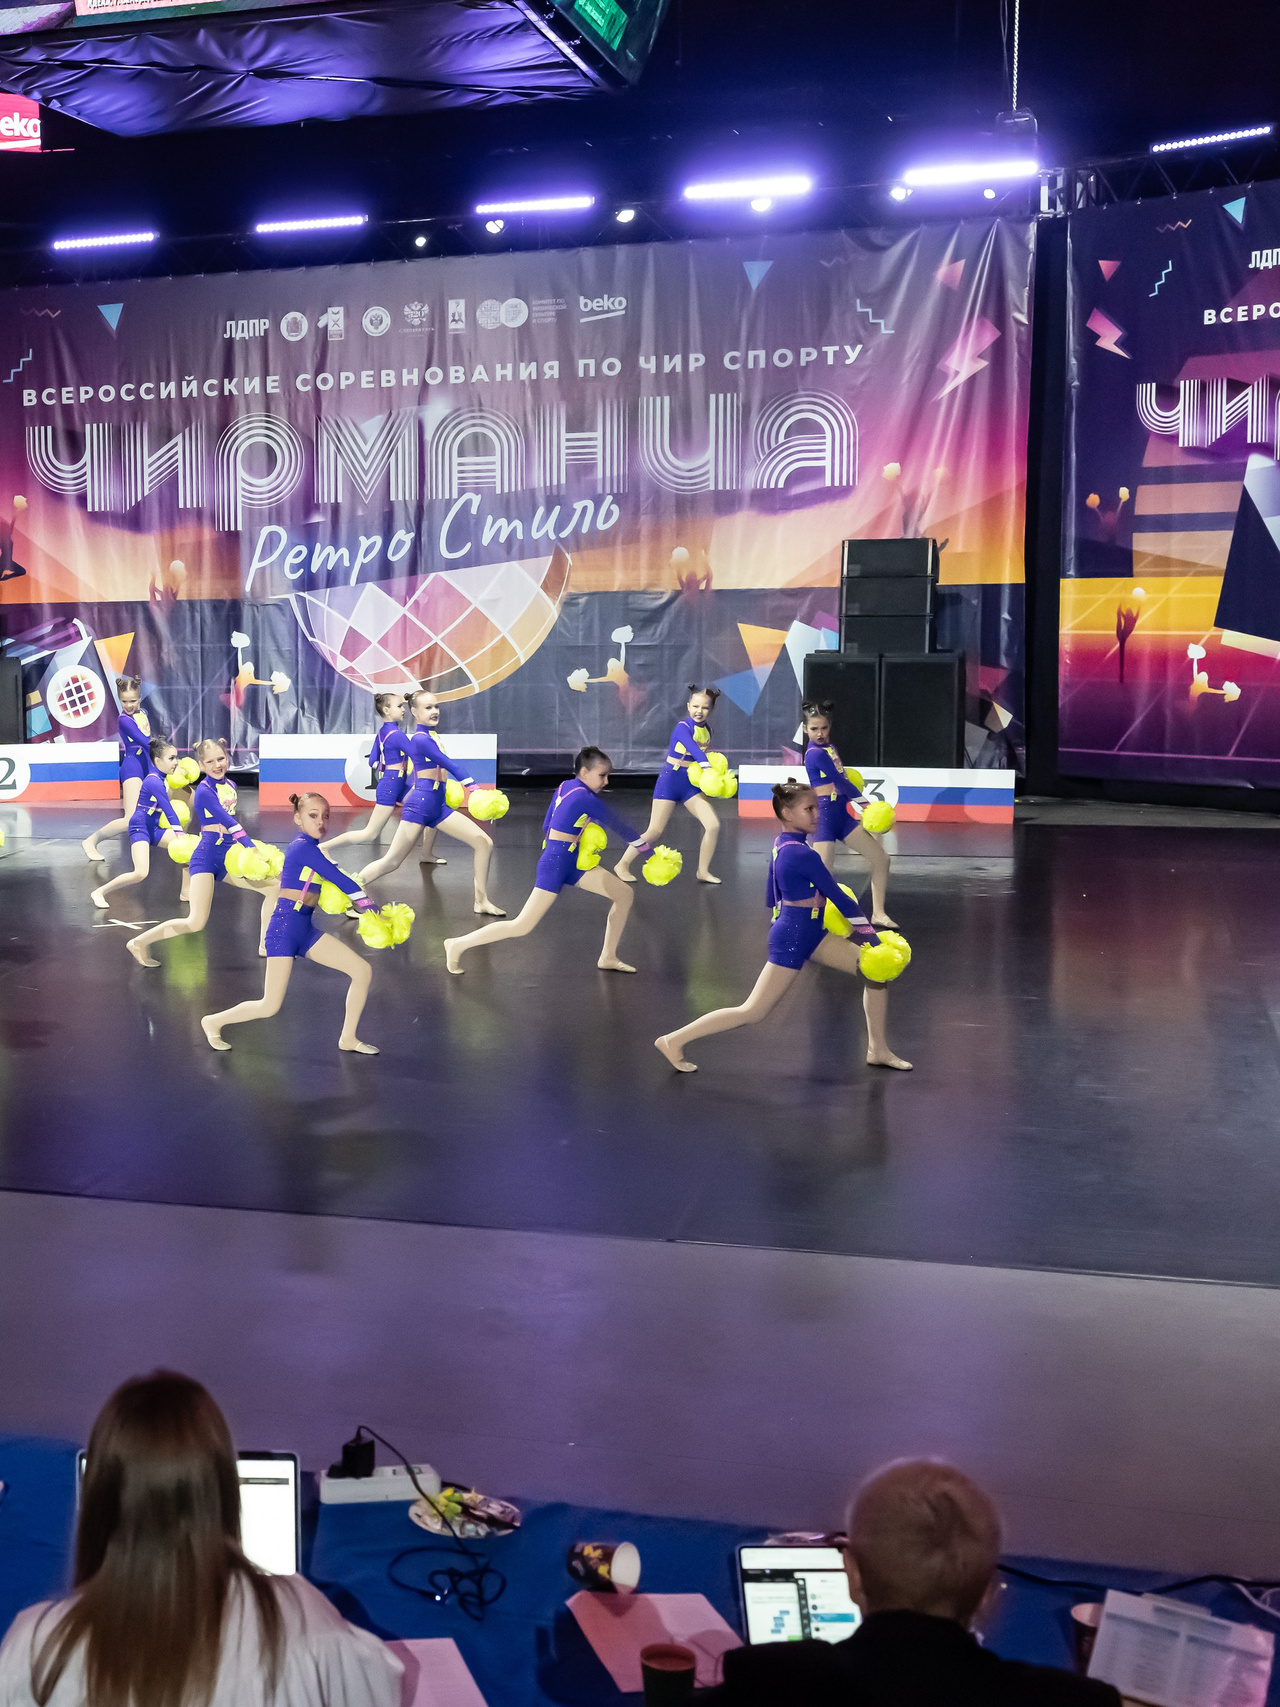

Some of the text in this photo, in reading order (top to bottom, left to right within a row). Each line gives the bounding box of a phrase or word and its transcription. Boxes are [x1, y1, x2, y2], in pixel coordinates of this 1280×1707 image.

[579, 294, 627, 312] beko
[223, 319, 270, 340] ЛДПР
[23, 344, 864, 407] ВСЕРОССИЙСКИЕ СОРЕВНОВАНИЯ ПО ЧИР СПОРТУ
[245, 492, 620, 592] Ретро Стиль
[863, 778, 886, 803] 3
